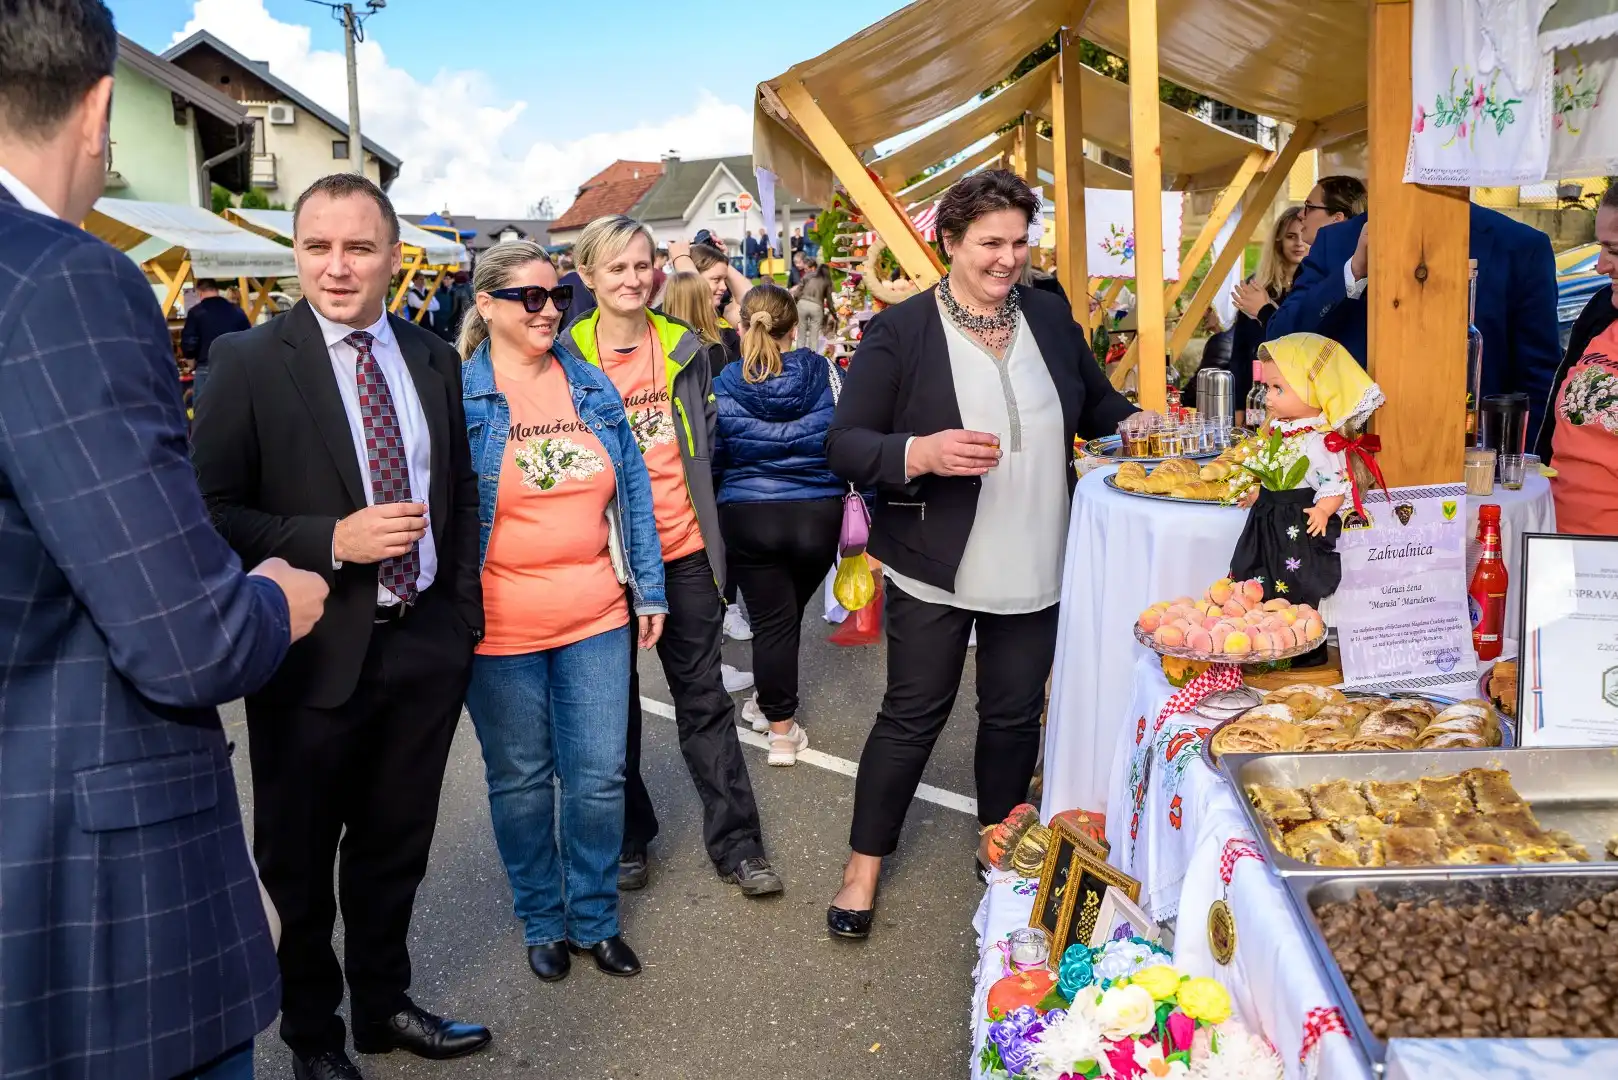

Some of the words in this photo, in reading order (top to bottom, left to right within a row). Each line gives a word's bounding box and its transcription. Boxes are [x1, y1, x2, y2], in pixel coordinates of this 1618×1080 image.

[1367, 542, 1433, 561] Zahvalnica
[1406, 584, 1422, 592] žena
[1401, 596, 1436, 606] Maruševec
